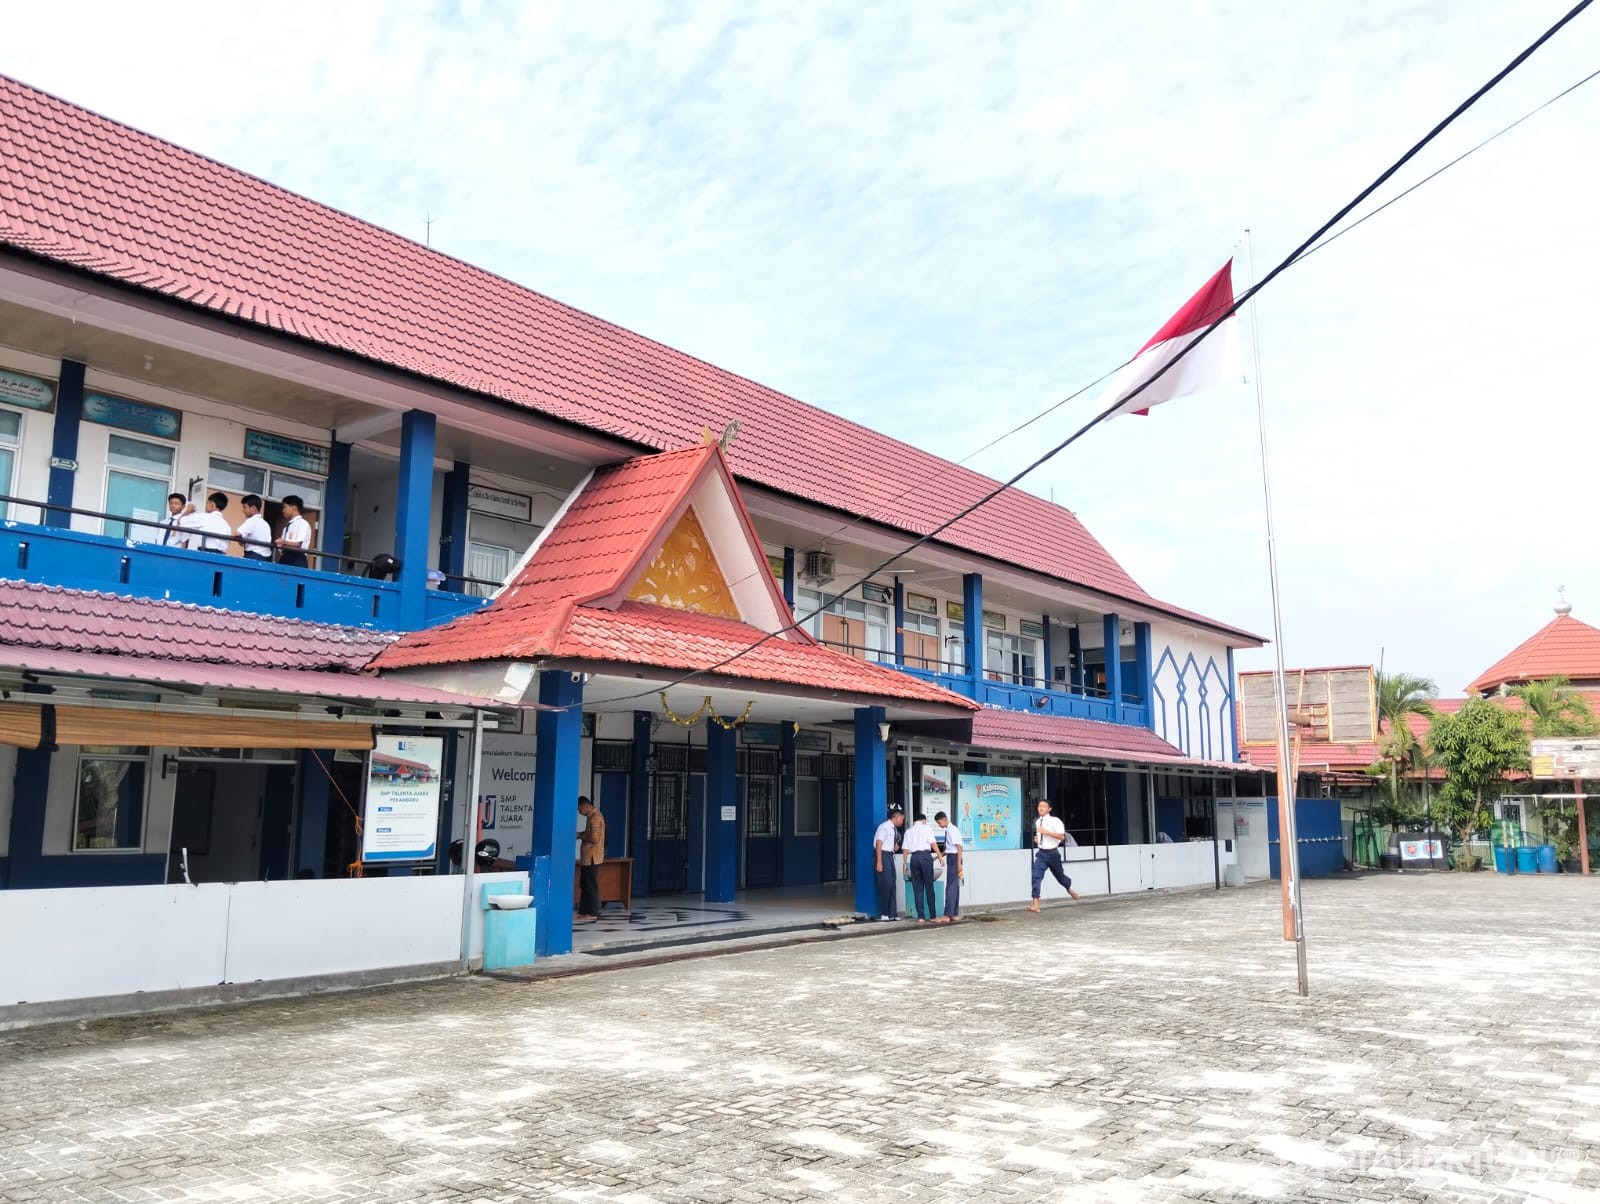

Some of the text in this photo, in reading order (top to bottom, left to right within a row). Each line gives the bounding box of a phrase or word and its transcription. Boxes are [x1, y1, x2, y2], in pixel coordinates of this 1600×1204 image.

[492, 768, 536, 781] Welcom
[500, 795, 517, 803] SMP
[500, 805, 533, 813] TALENTA
[499, 815, 523, 823] JUARA
